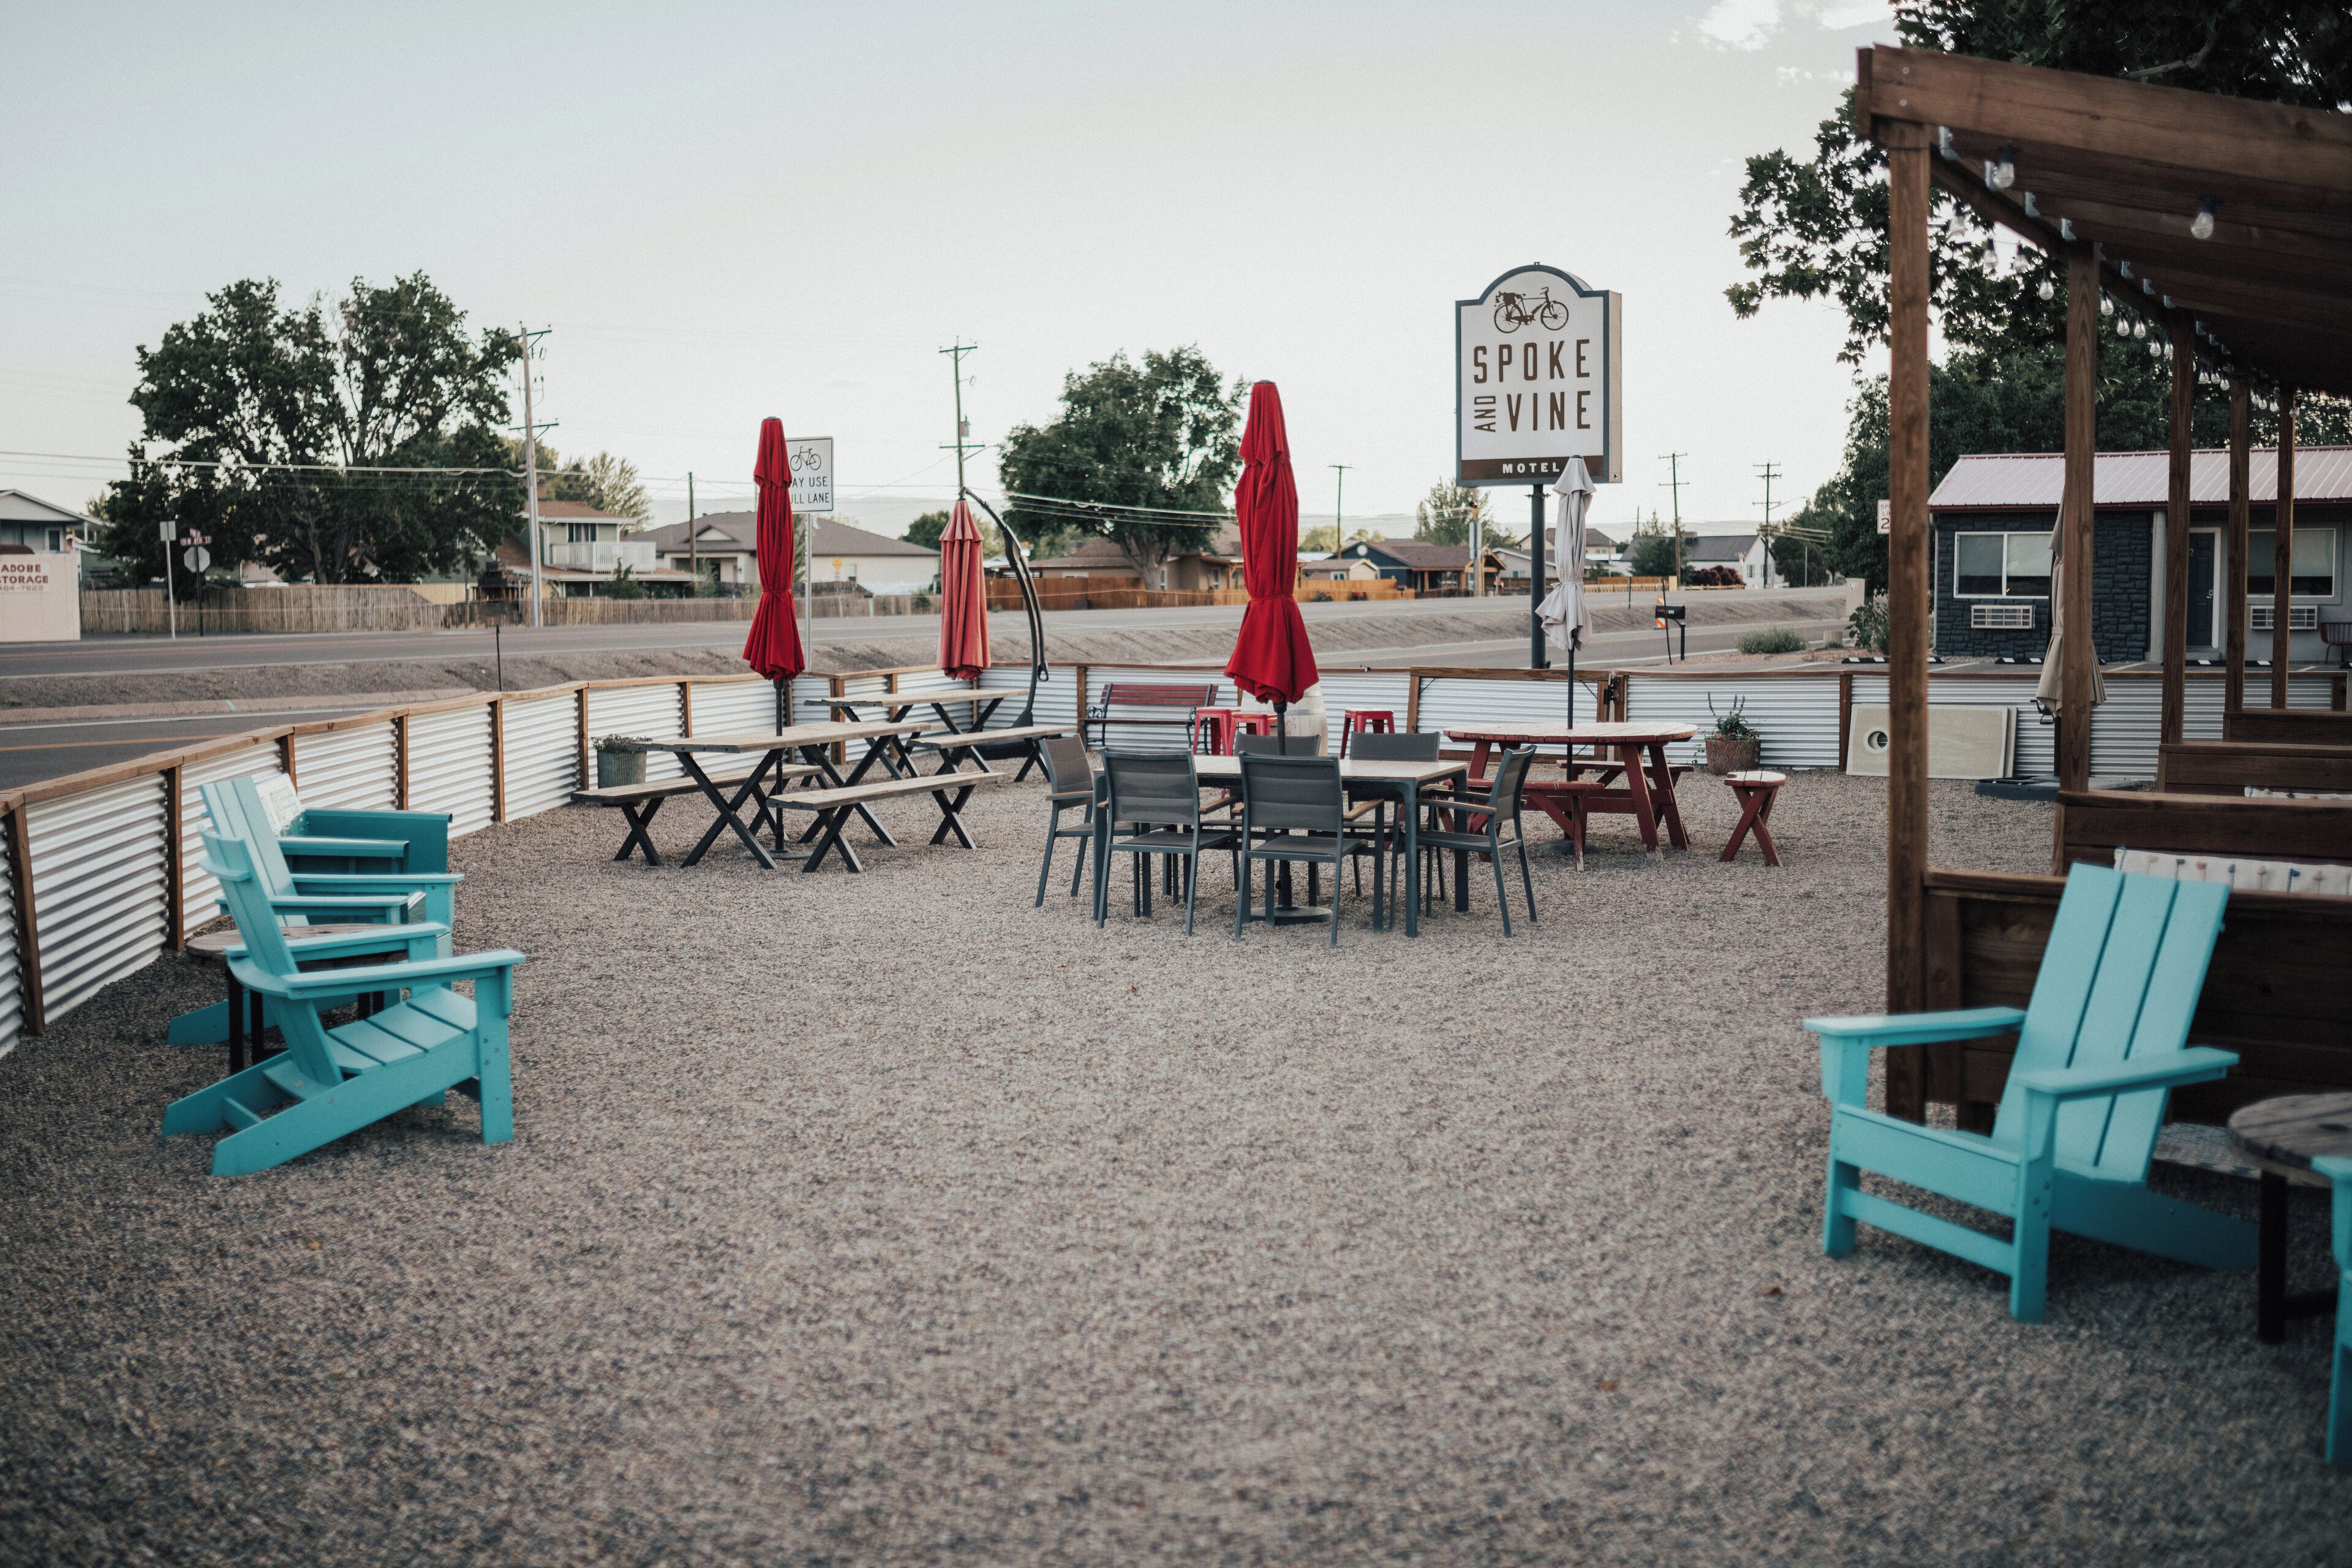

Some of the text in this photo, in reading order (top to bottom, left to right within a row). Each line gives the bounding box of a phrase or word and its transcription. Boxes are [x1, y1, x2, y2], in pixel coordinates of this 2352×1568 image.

[1474, 339, 1590, 384] SPOKE
[1474, 395, 1496, 432] AND
[1506, 391, 1591, 432] VINE
[1502, 462, 1560, 474] MOTEL
[791, 476, 828, 488] AY USE
[791, 492, 830, 503] ULL LANE
[1881, 518, 1890, 529] 2
[1, 564, 41, 573] ADOBE
